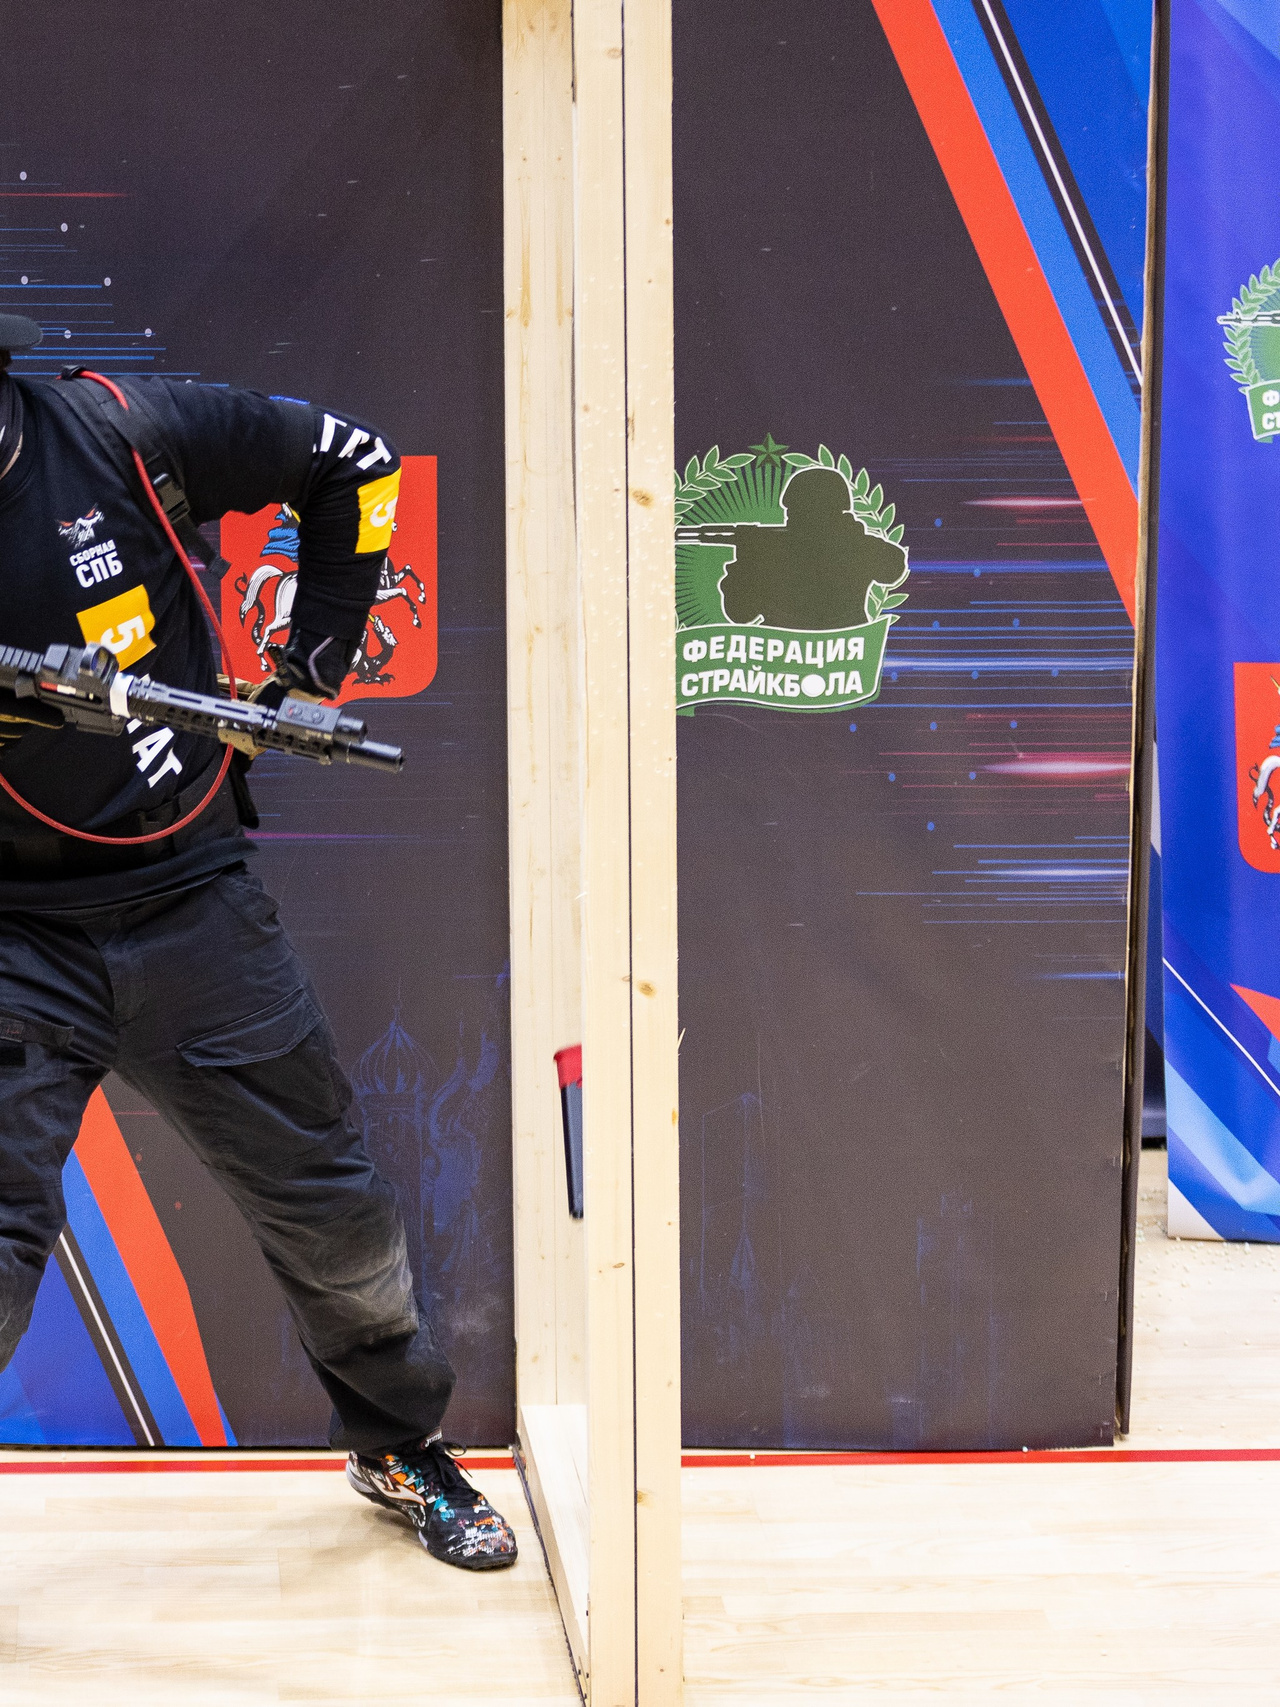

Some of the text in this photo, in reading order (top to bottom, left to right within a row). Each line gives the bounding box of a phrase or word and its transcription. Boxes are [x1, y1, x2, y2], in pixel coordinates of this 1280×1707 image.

[69, 539, 117, 567] СБОРНАЯ
[75, 550, 124, 589] СПБ
[99, 614, 146, 655] 5
[682, 634, 865, 669] ФЕДЕРАЦИЯ
[680, 664, 864, 698] СТРАЙКБОЛА
